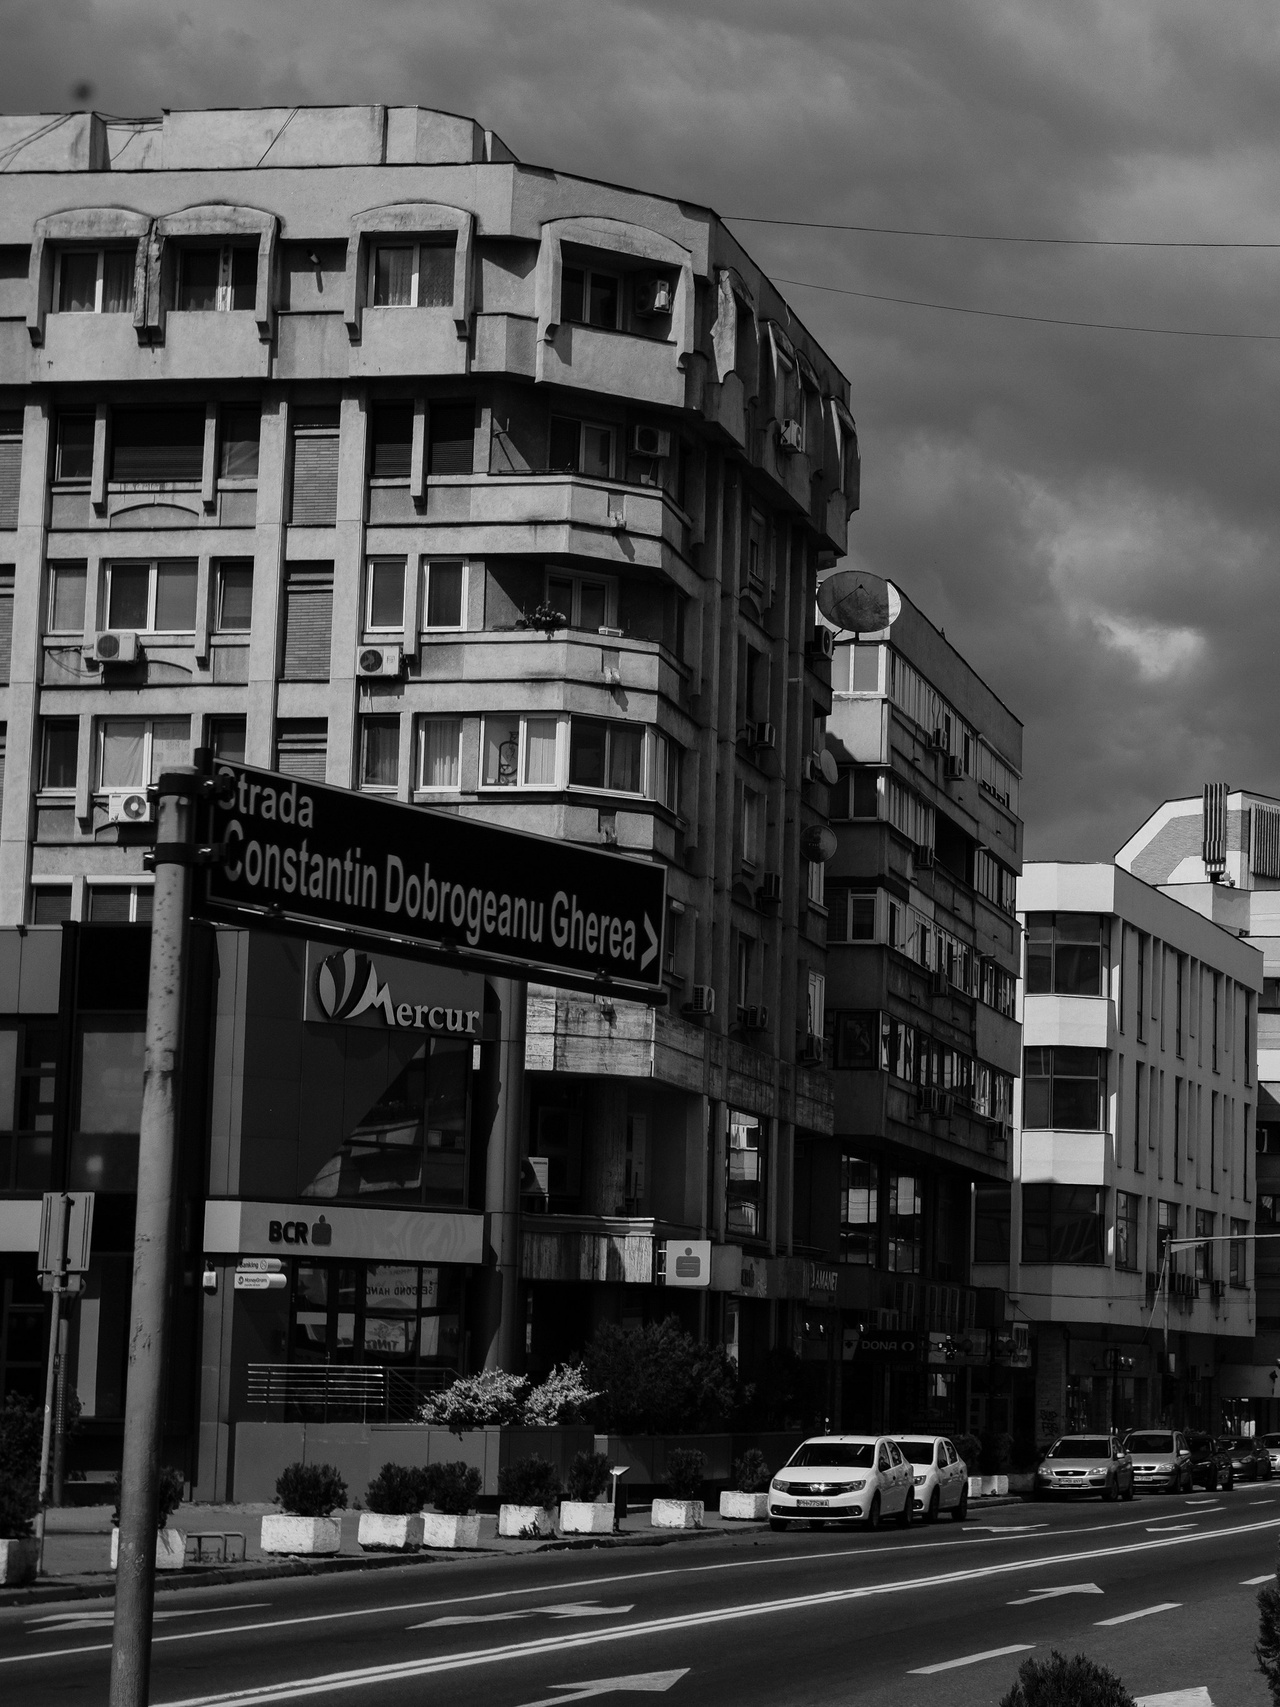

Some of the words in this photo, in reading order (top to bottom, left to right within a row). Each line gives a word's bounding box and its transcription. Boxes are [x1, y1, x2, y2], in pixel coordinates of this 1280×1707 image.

[223, 818, 378, 910] Constantin
[384, 853, 545, 946] Dobrogeanu
[550, 890, 637, 961] Gherea
[342, 960, 480, 1034] Mercur
[269, 1220, 308, 1244] BCR
[861, 1340, 898, 1351] DONA
